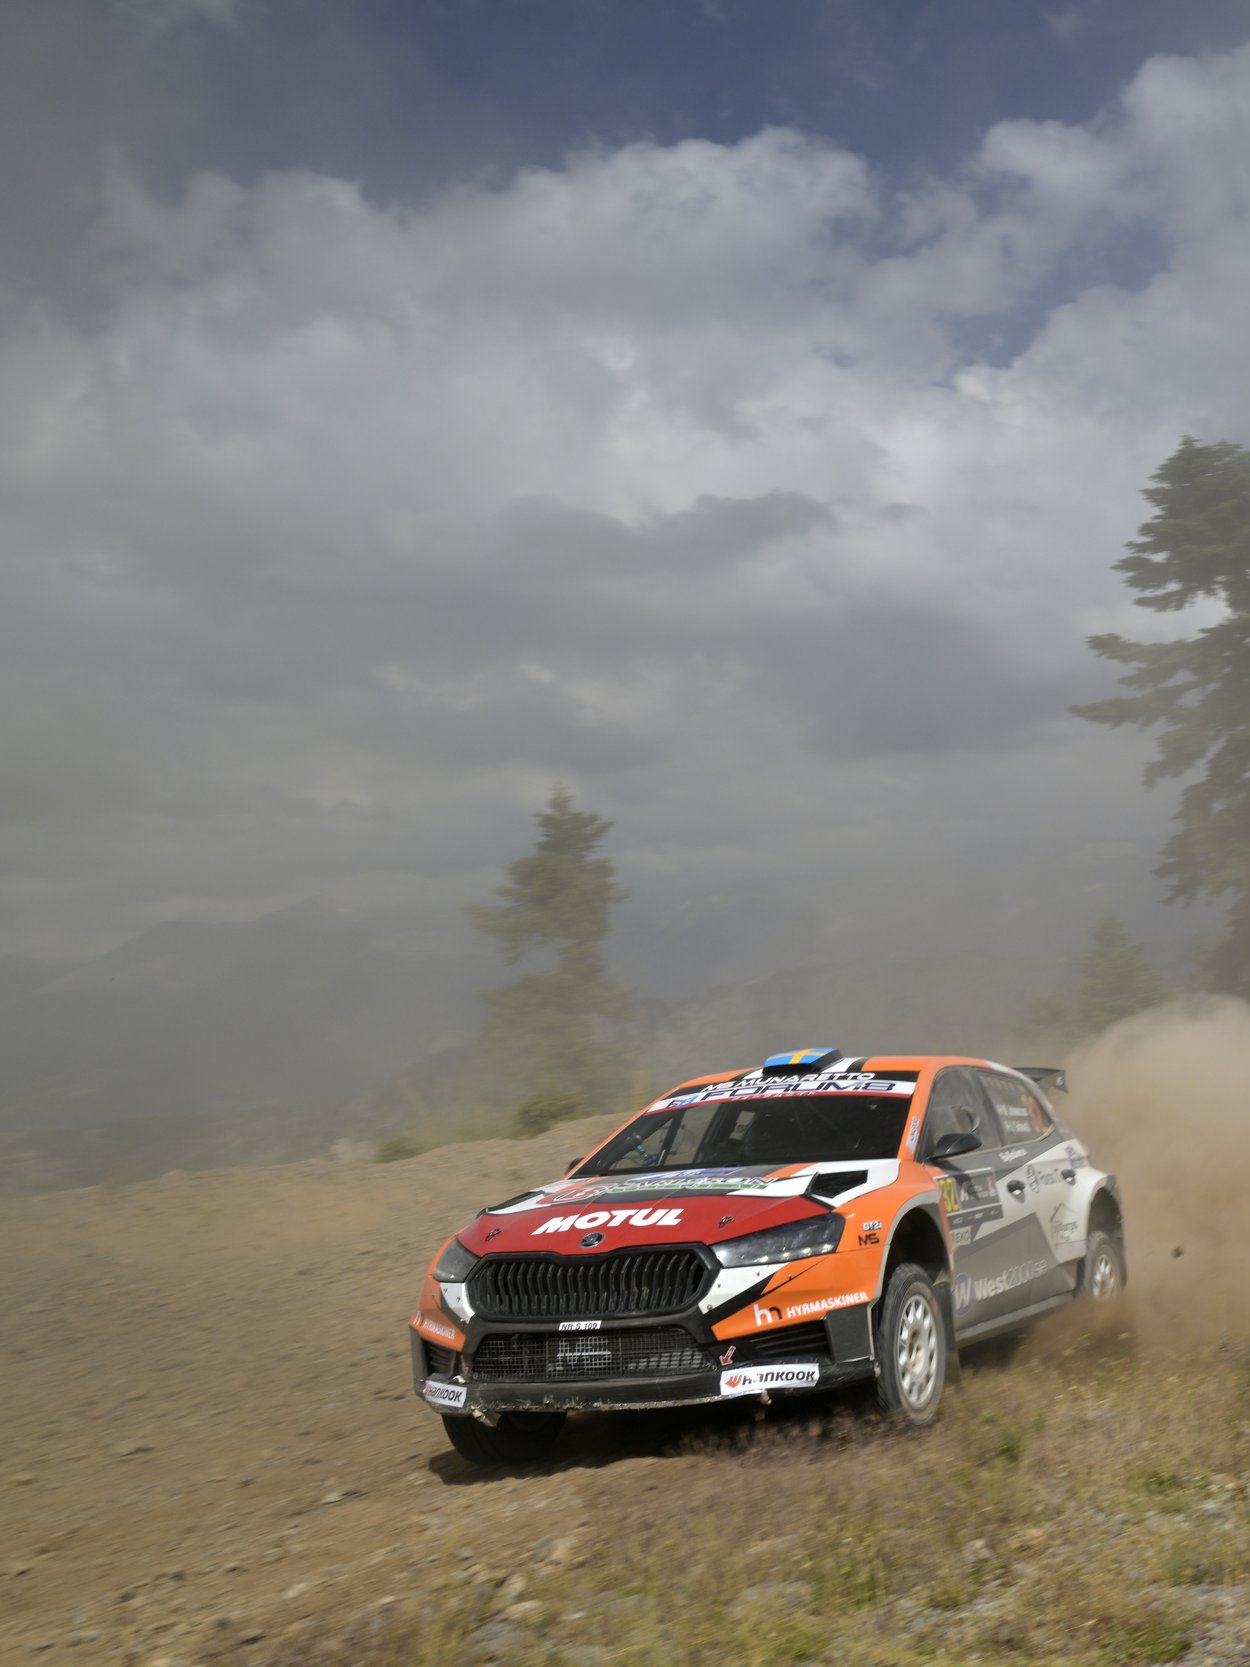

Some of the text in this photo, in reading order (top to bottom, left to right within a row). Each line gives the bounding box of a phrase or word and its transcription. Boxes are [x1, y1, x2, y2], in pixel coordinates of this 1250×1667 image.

[701, 1081, 896, 1101] FORUM8
[734, 1072, 876, 1088] MUNARETTO
[939, 1178, 960, 1212] 32
[530, 1208, 684, 1236] MOTUL
[786, 1291, 868, 1319] HYRMASKINER
[561, 1321, 600, 1331] NR S 109
